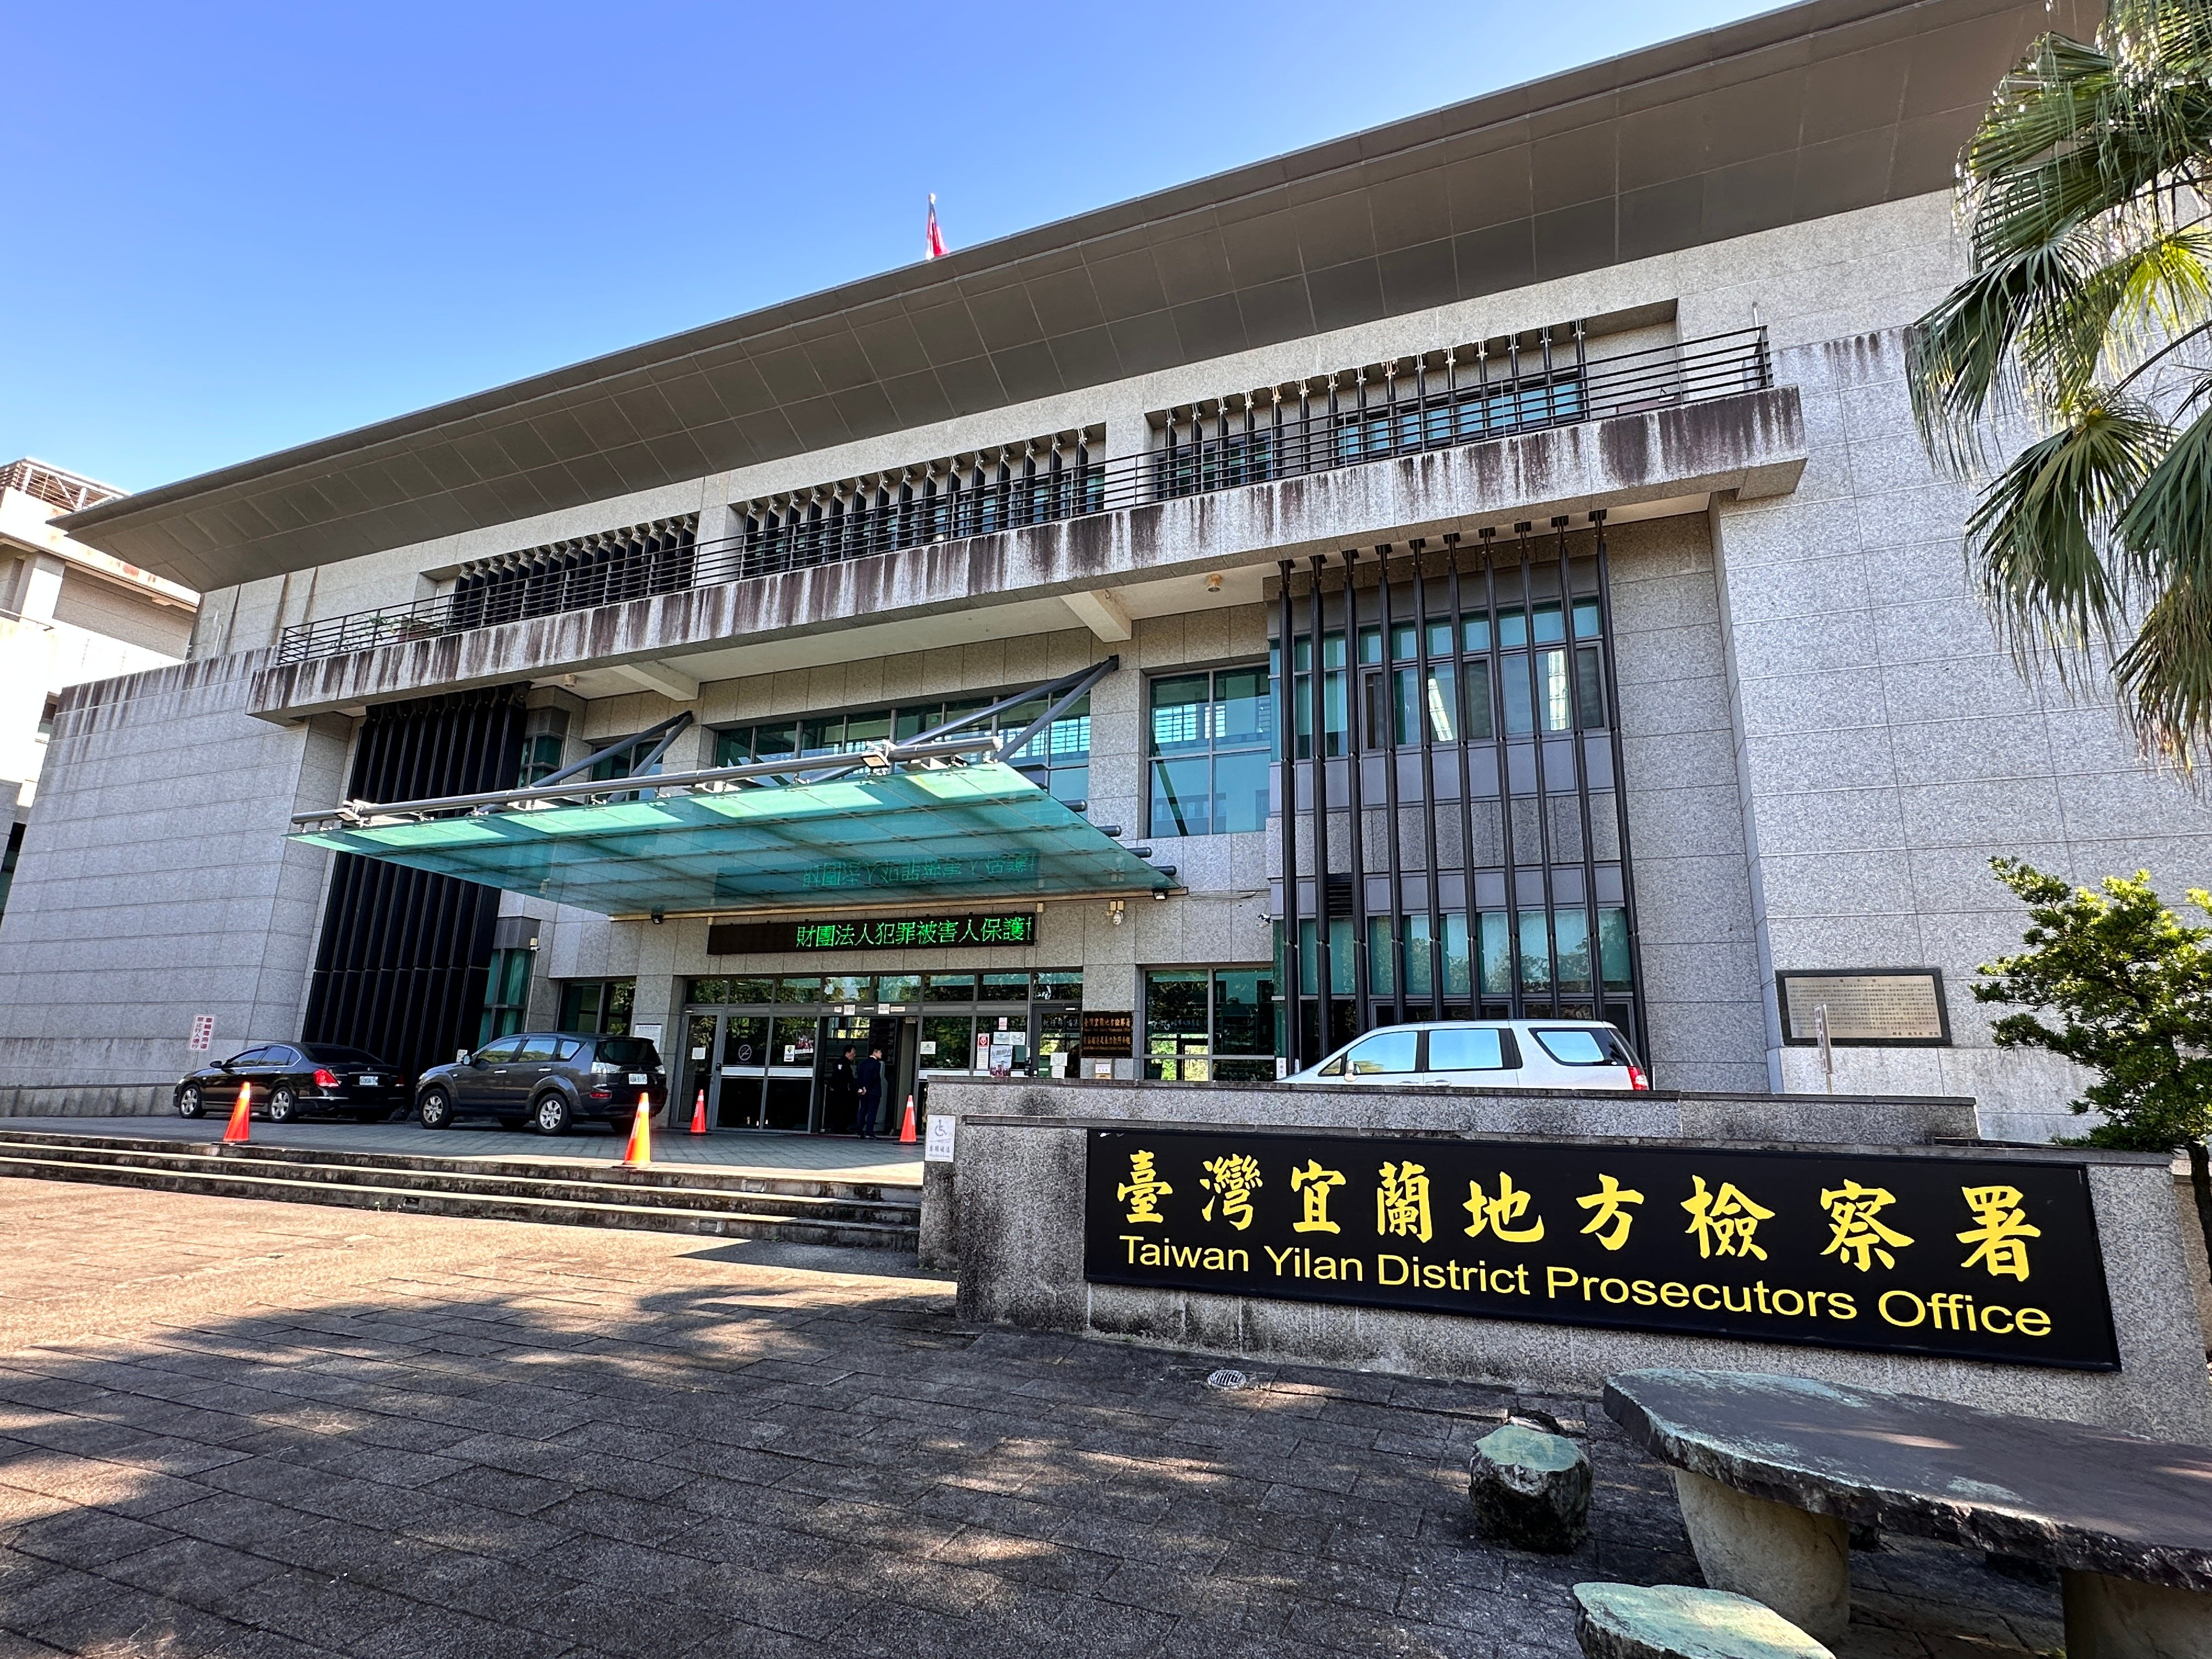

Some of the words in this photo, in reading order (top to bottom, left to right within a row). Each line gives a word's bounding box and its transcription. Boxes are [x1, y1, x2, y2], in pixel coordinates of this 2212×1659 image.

[795, 917, 1032, 948] 財團法人犯罪被害人保護
[1116, 1150, 2041, 1282] 臺灣宜蘭地方檢察署
[1119, 1235, 1249, 1272] Taiwan
[1264, 1245, 1363, 1282] Yilan
[1378, 1255, 1530, 1295] District
[1547, 1267, 1858, 1319] Prosecutors
[1878, 1290, 2052, 1336] Office
